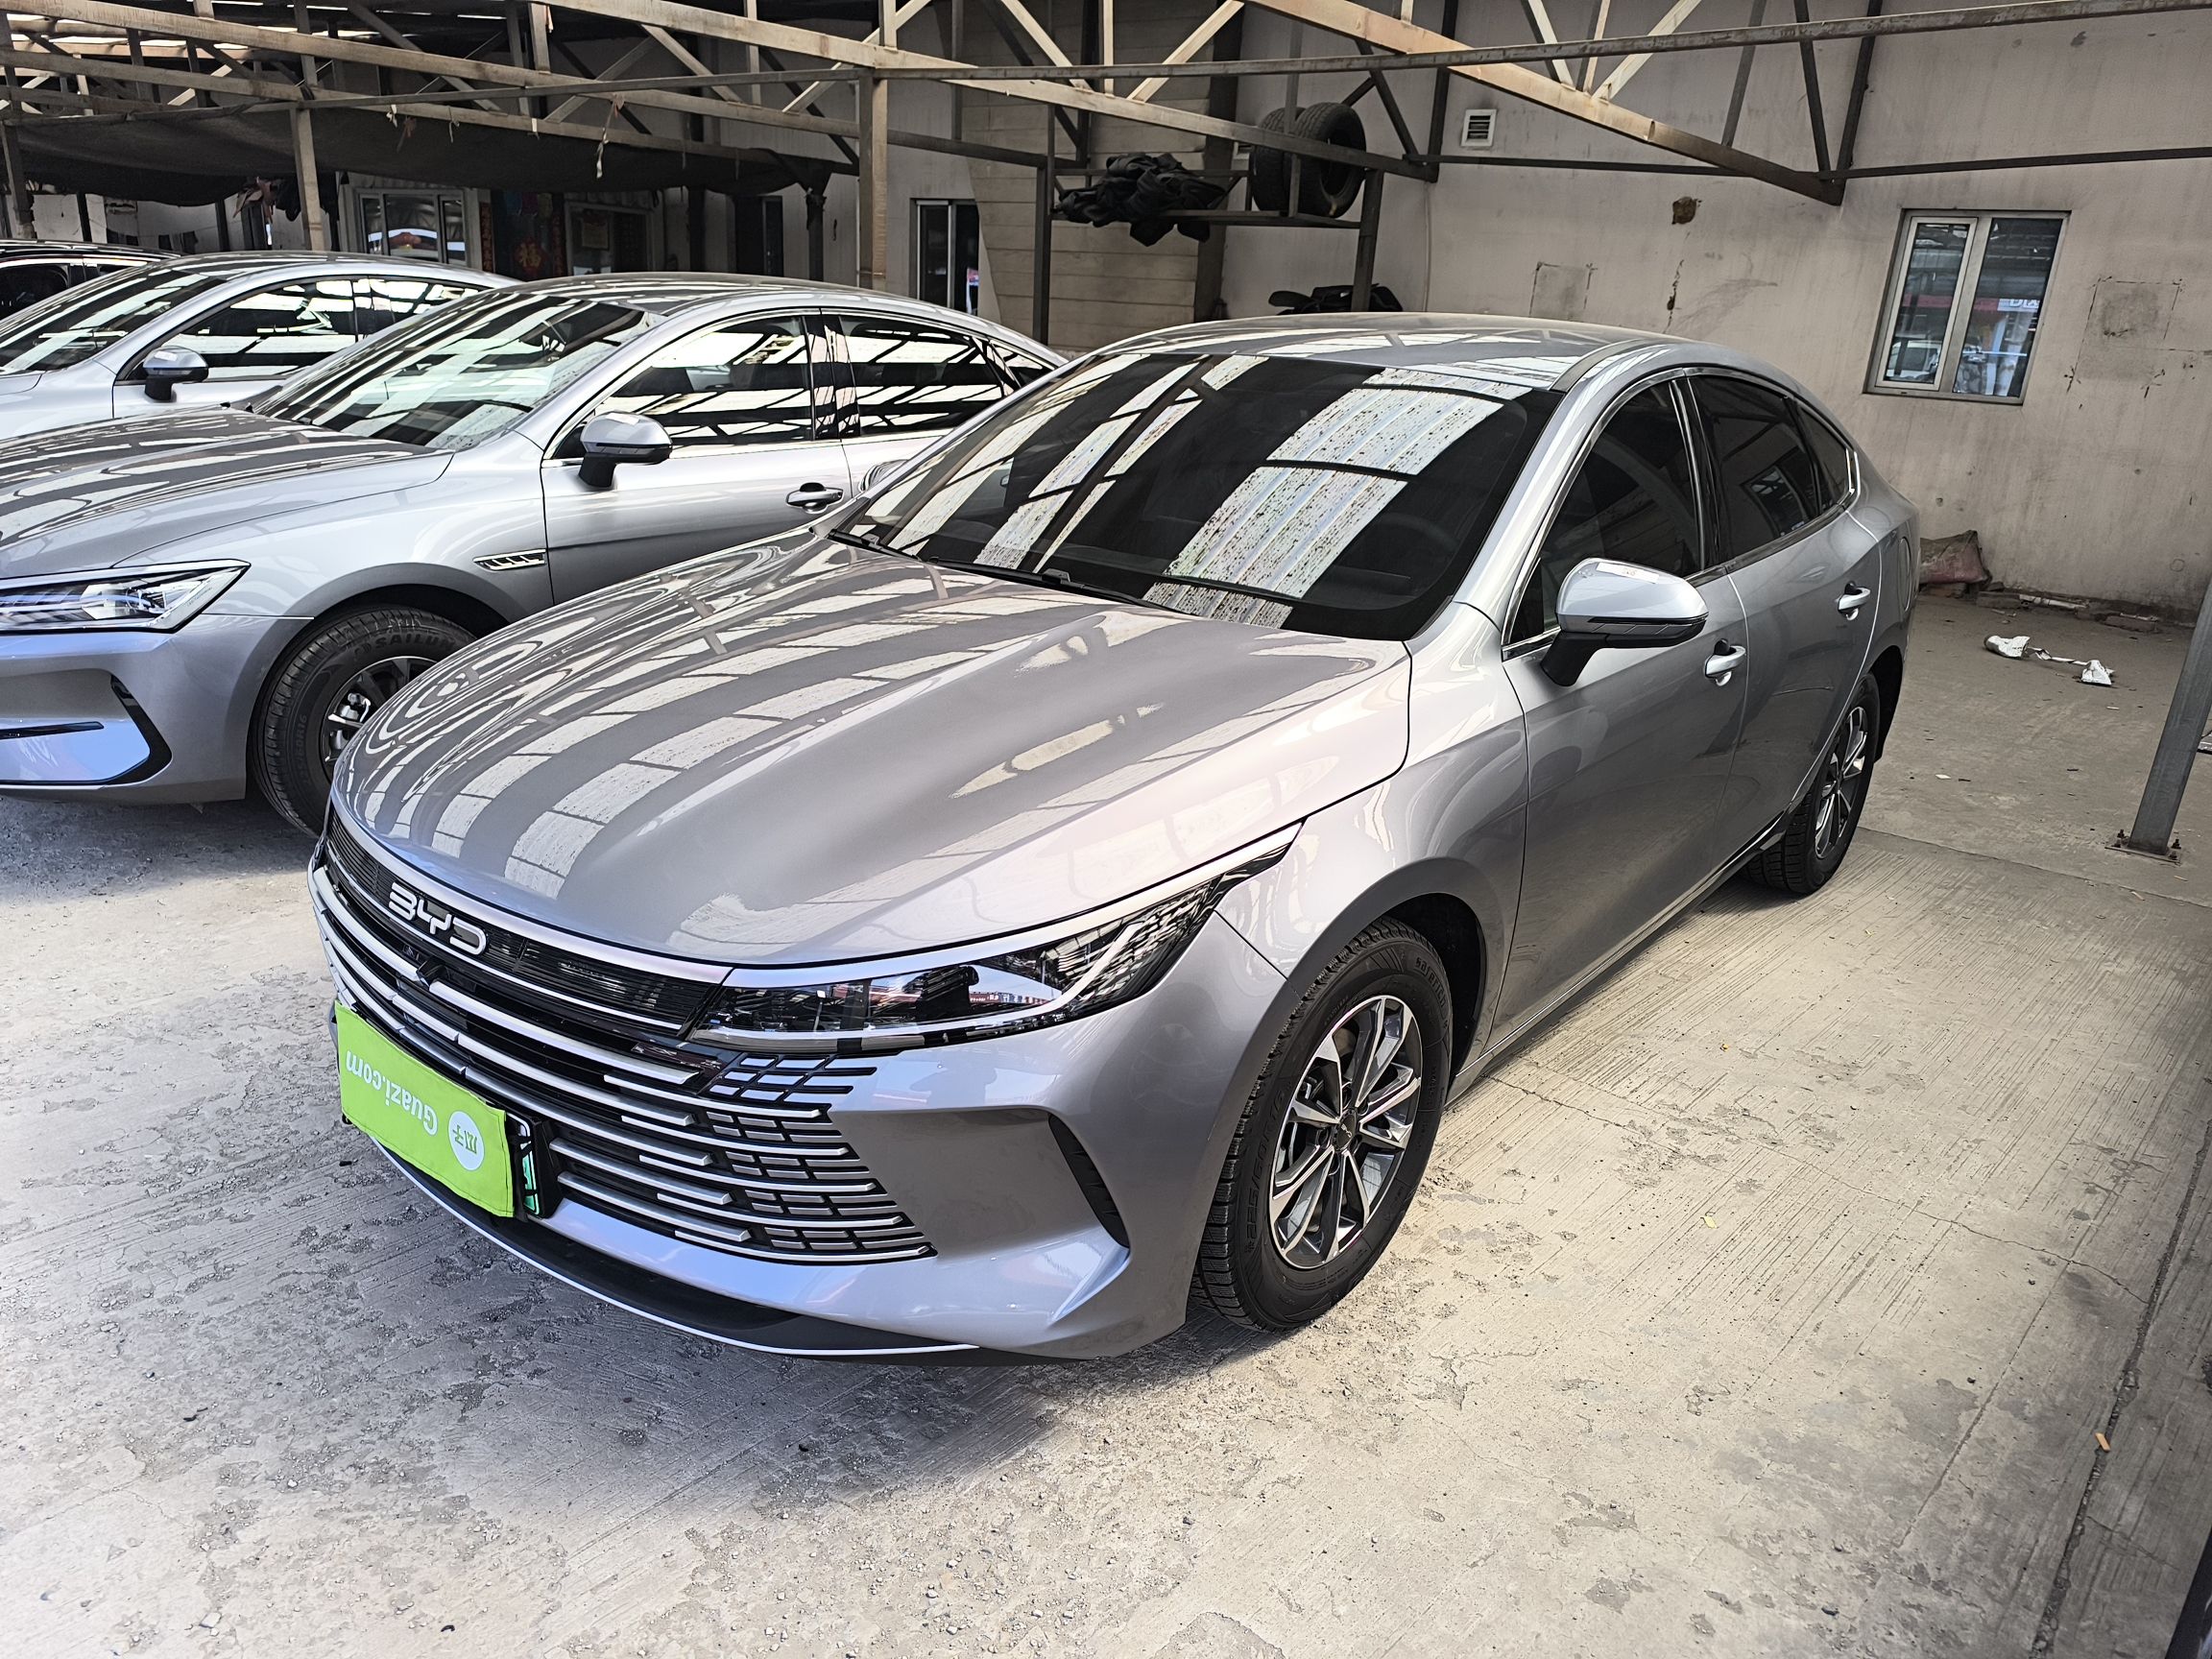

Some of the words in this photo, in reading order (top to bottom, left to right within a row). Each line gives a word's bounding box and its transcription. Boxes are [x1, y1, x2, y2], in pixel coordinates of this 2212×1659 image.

[388, 881, 491, 956] BYD
[345, 1050, 439, 1137] Guazi.com
[452, 1124, 478, 1154] 瓜子
